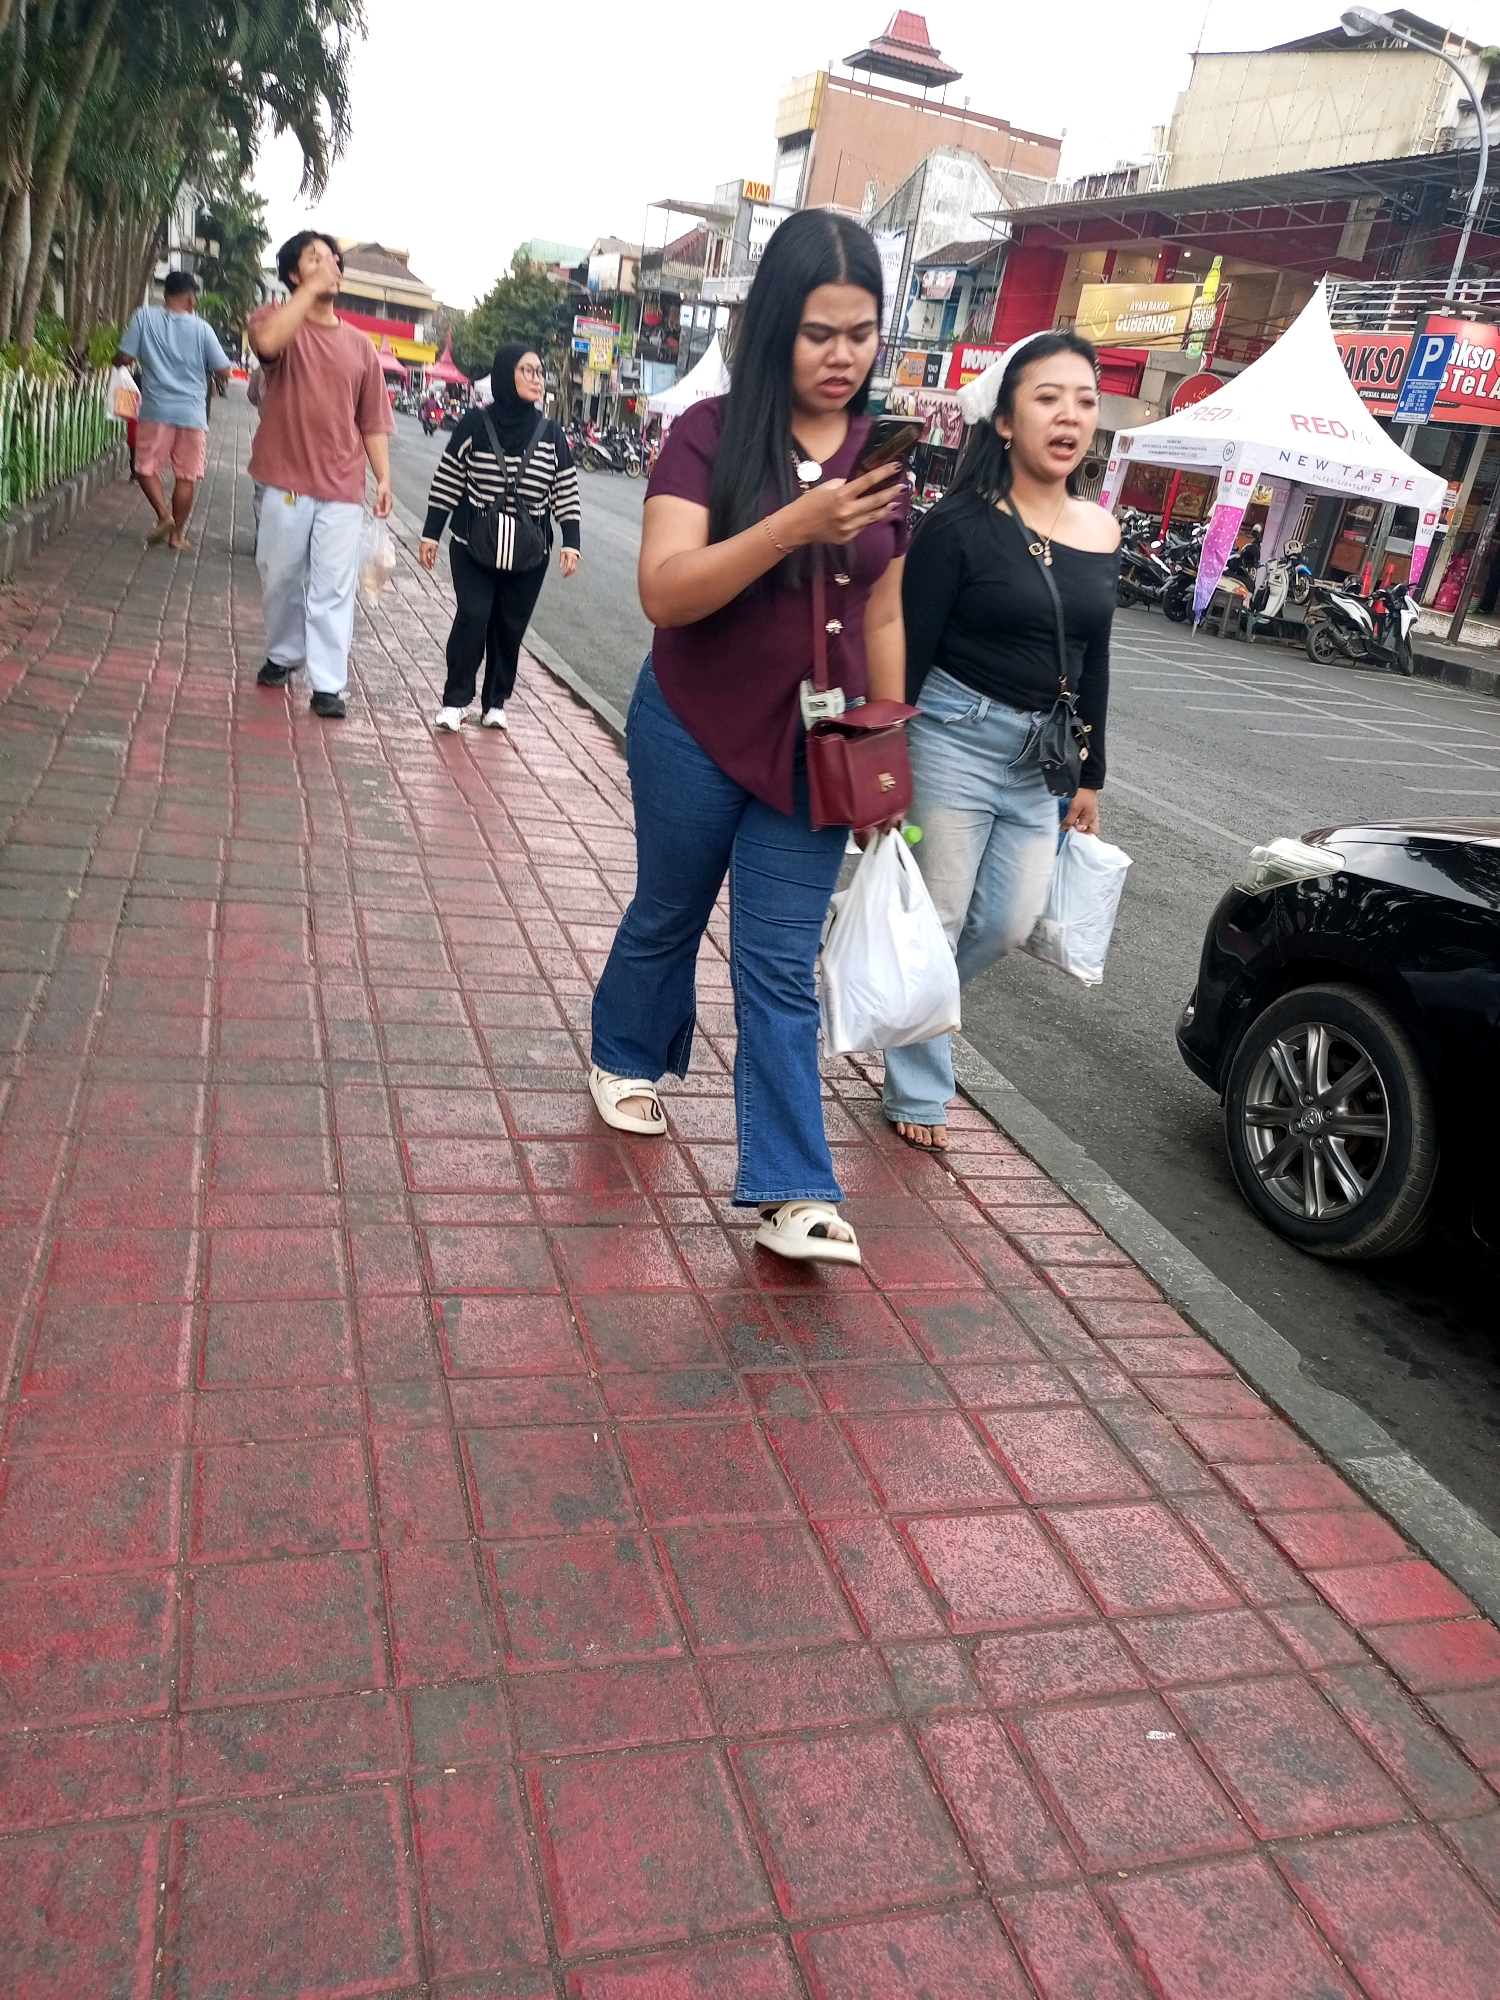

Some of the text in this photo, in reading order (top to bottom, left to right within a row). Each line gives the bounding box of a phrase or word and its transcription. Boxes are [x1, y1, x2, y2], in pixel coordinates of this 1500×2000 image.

[1129, 301, 1171, 312] AYAM BAKAR
[1115, 313, 1177, 334] GUBERNUR
[960, 348, 1006, 371] MOMO
[1417, 337, 1445, 377] P
[1447, 338, 1496, 371] akso
[1439, 368, 1500, 400] eTéLA
[1358, 390, 1380, 400] SPESIAL
[1380, 391, 1399, 401] BAKSO
[1184, 406, 1234, 422] RED
[1289, 413, 1349, 439] RED
[1241, 473, 1251, 484] 16
[1279, 450, 1416, 491] NEW TASTE
[1312, 474, 1335, 484] FILTER
[1426, 514, 1434, 524] 16
